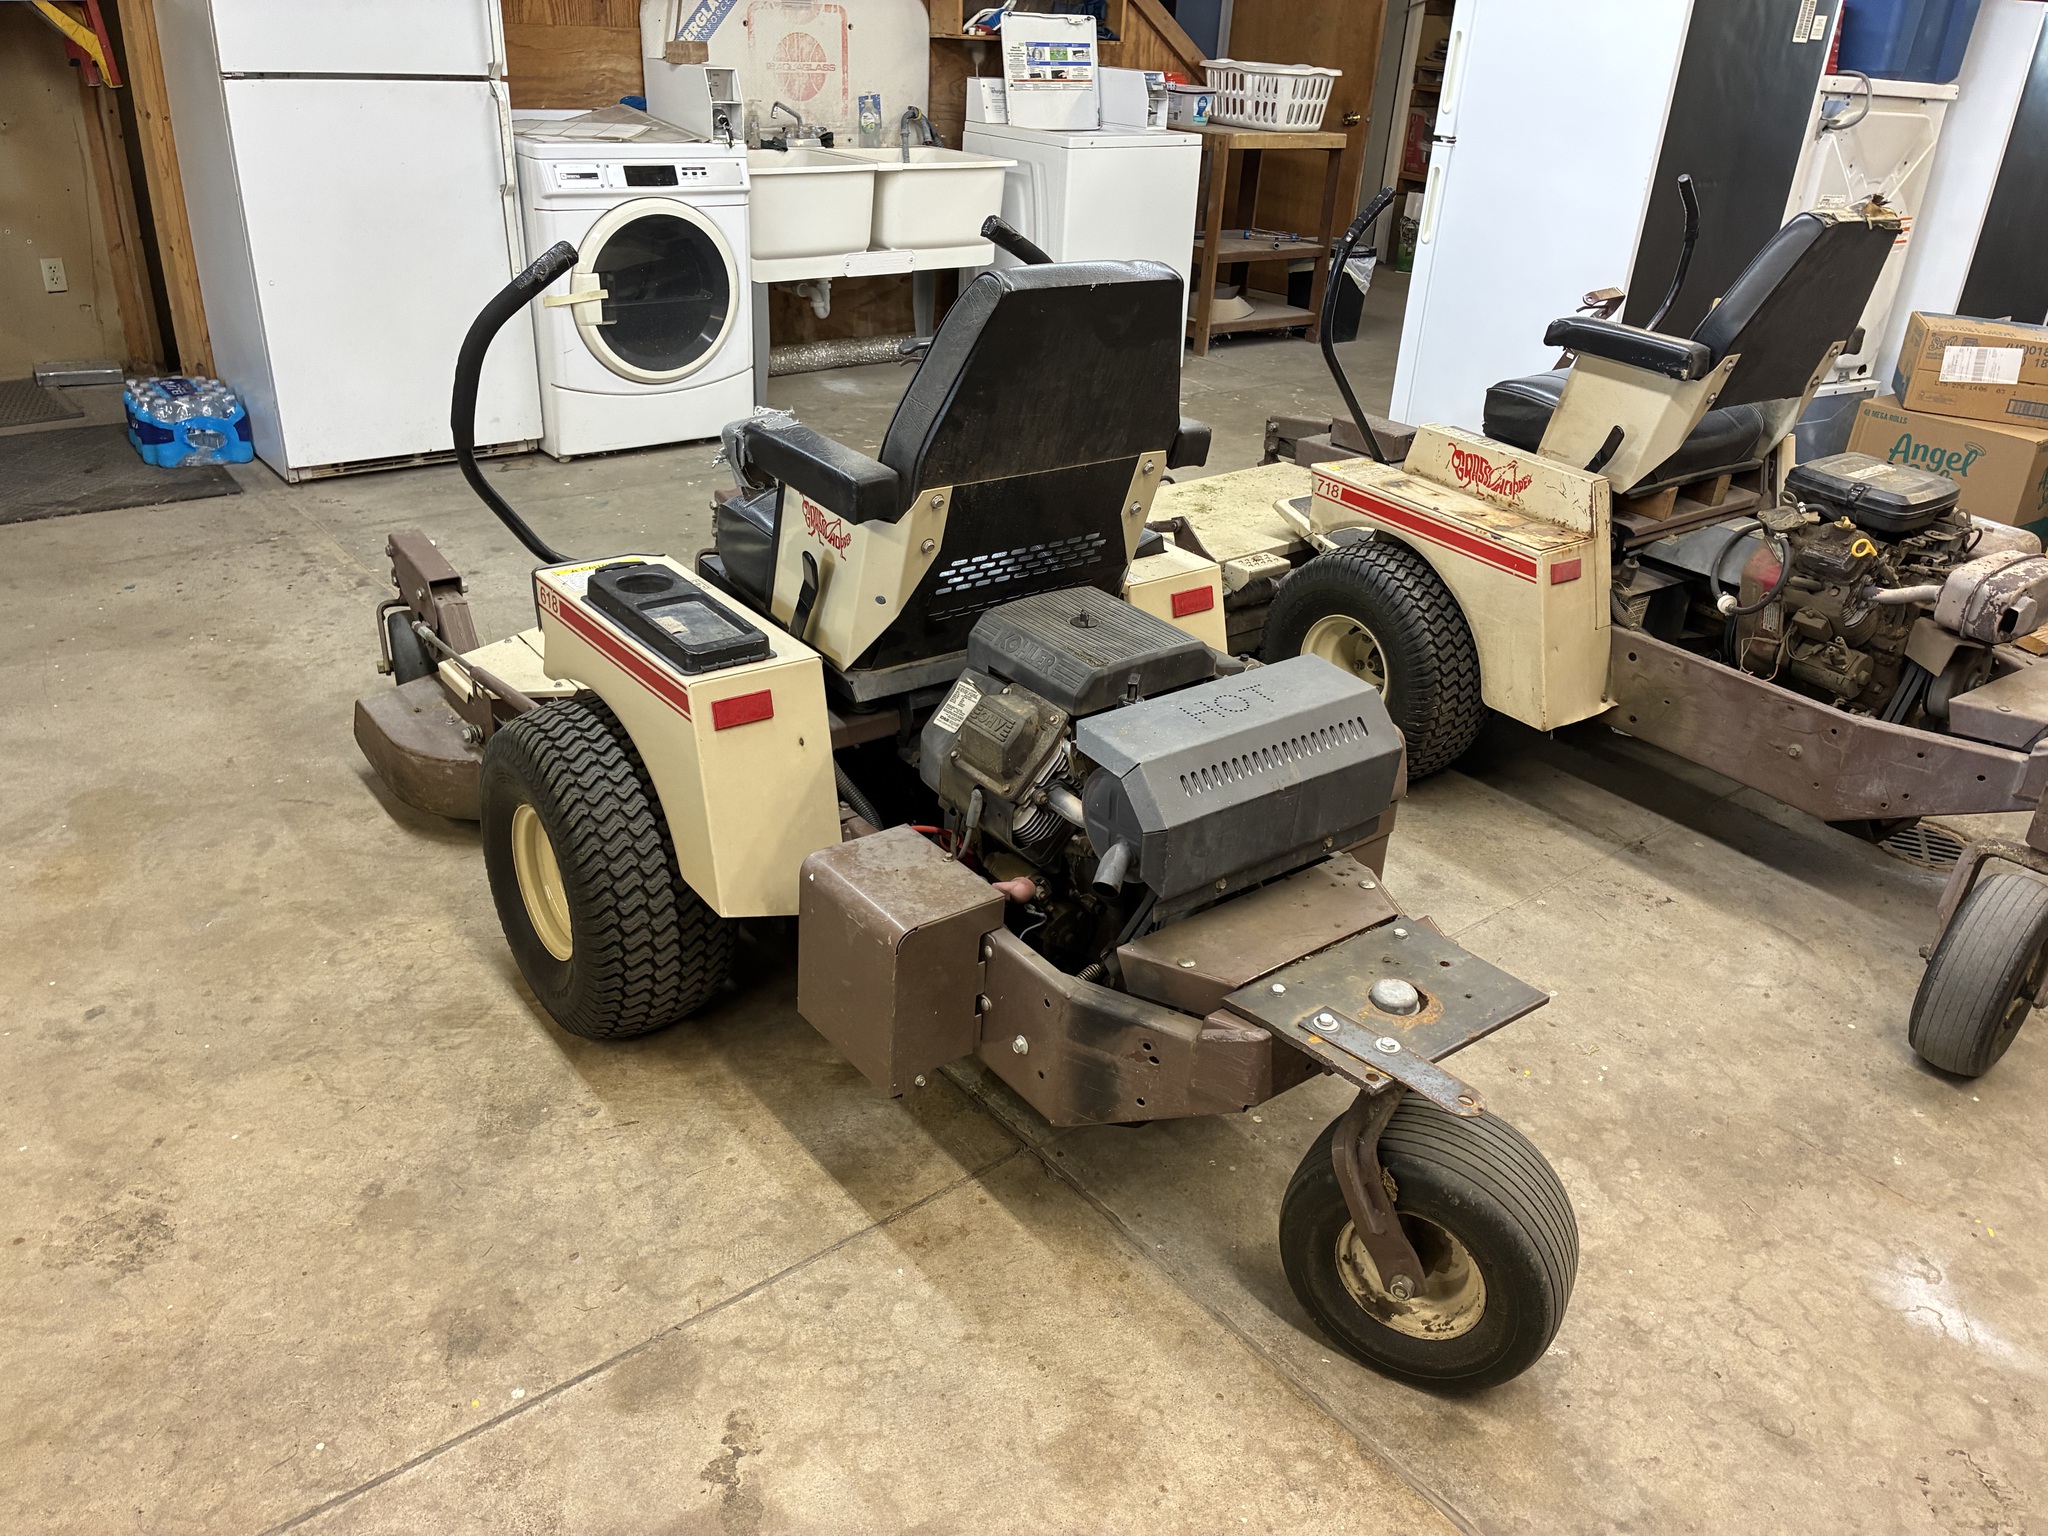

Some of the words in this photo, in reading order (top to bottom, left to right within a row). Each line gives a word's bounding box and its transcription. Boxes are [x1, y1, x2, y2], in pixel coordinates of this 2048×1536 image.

[679, 0, 722, 41] ERGLA
[1871, 410, 1888, 421] MEGA
[1889, 414, 1908, 425] ROLLS
[1888, 433, 1979, 478] Angel
[1317, 478, 1340, 499] 718
[540, 586, 559, 614] 618
[994, 628, 1056, 676] KOHLER
[1178, 683, 1275, 724] HOT
